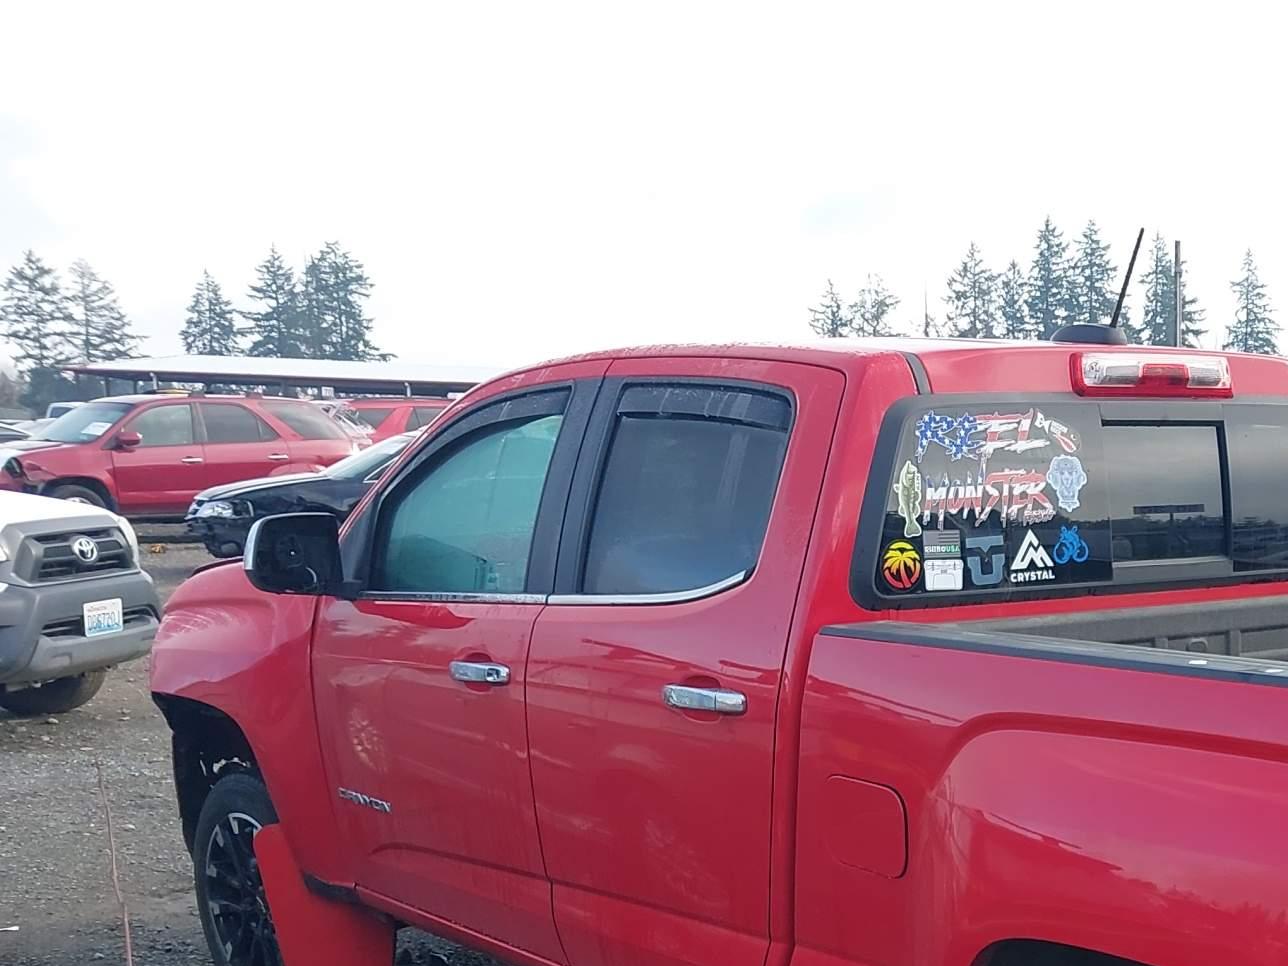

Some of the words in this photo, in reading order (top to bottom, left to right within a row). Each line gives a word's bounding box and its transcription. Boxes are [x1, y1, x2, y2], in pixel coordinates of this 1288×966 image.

[915, 408, 1050, 463] REEL
[922, 468, 1056, 530] MONSTER
[1010, 569, 1055, 583] CRYSTAL
